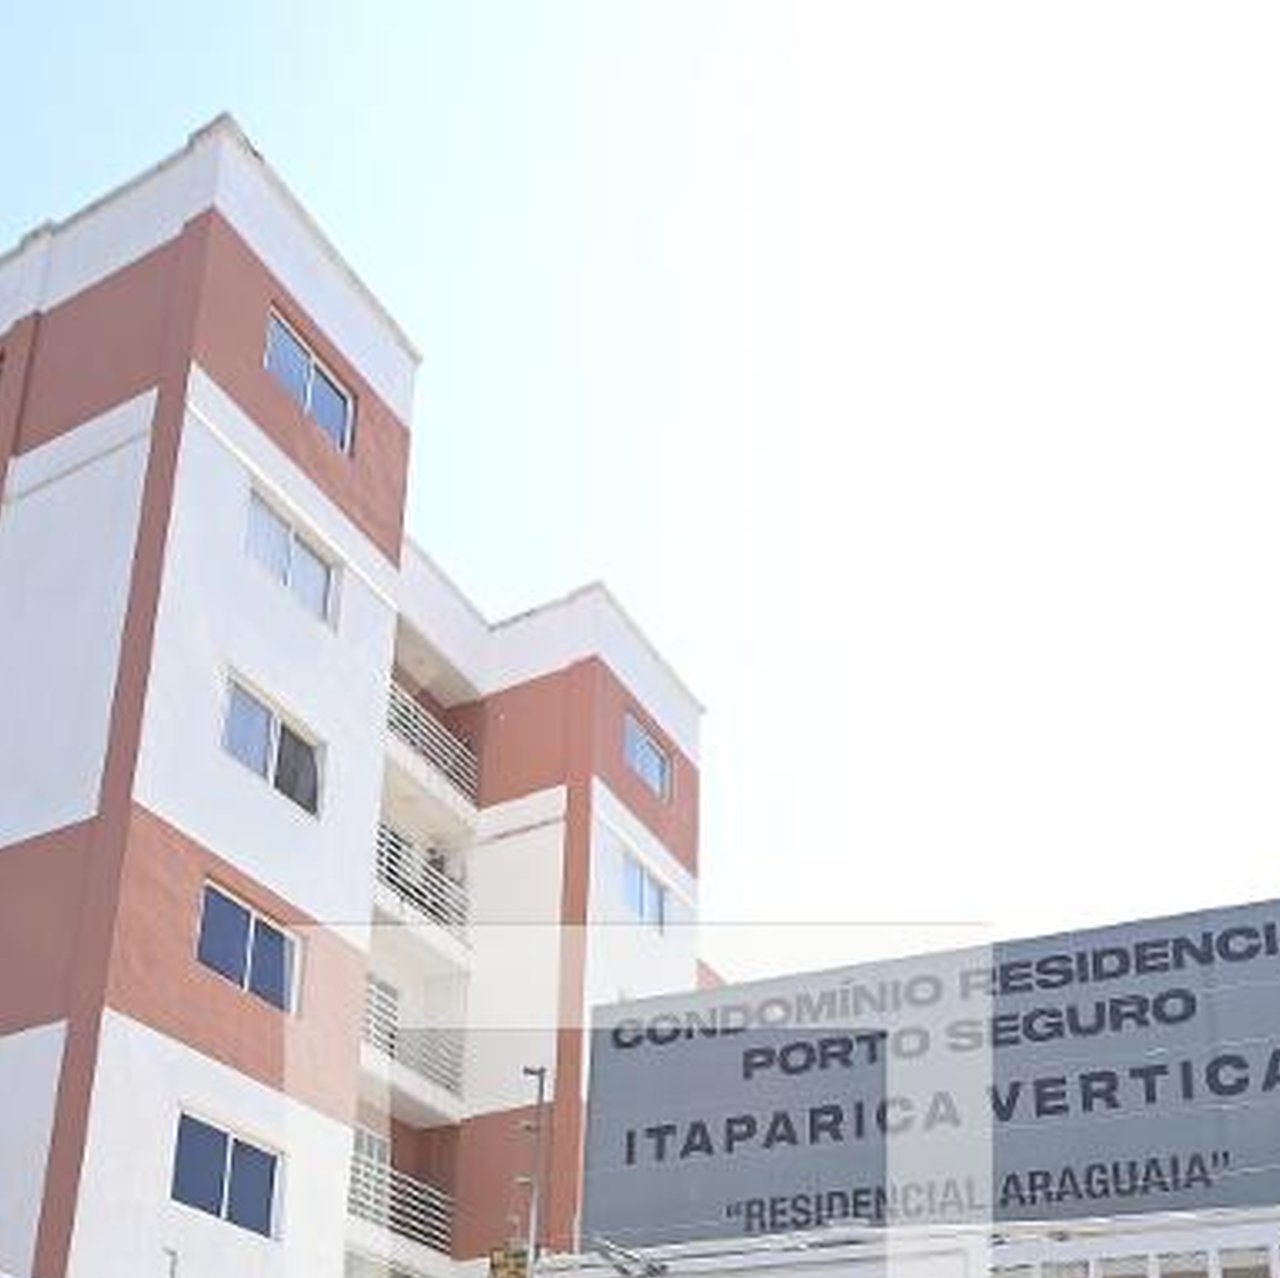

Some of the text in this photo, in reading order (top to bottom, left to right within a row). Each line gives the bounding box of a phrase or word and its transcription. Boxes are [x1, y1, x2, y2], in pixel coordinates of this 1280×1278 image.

[610, 973, 943, 1049] CONDOMÍNIO
[742, 988, 1198, 1080] PORTO SEGURO
[624, 1089, 961, 1165] ITAPARICA
